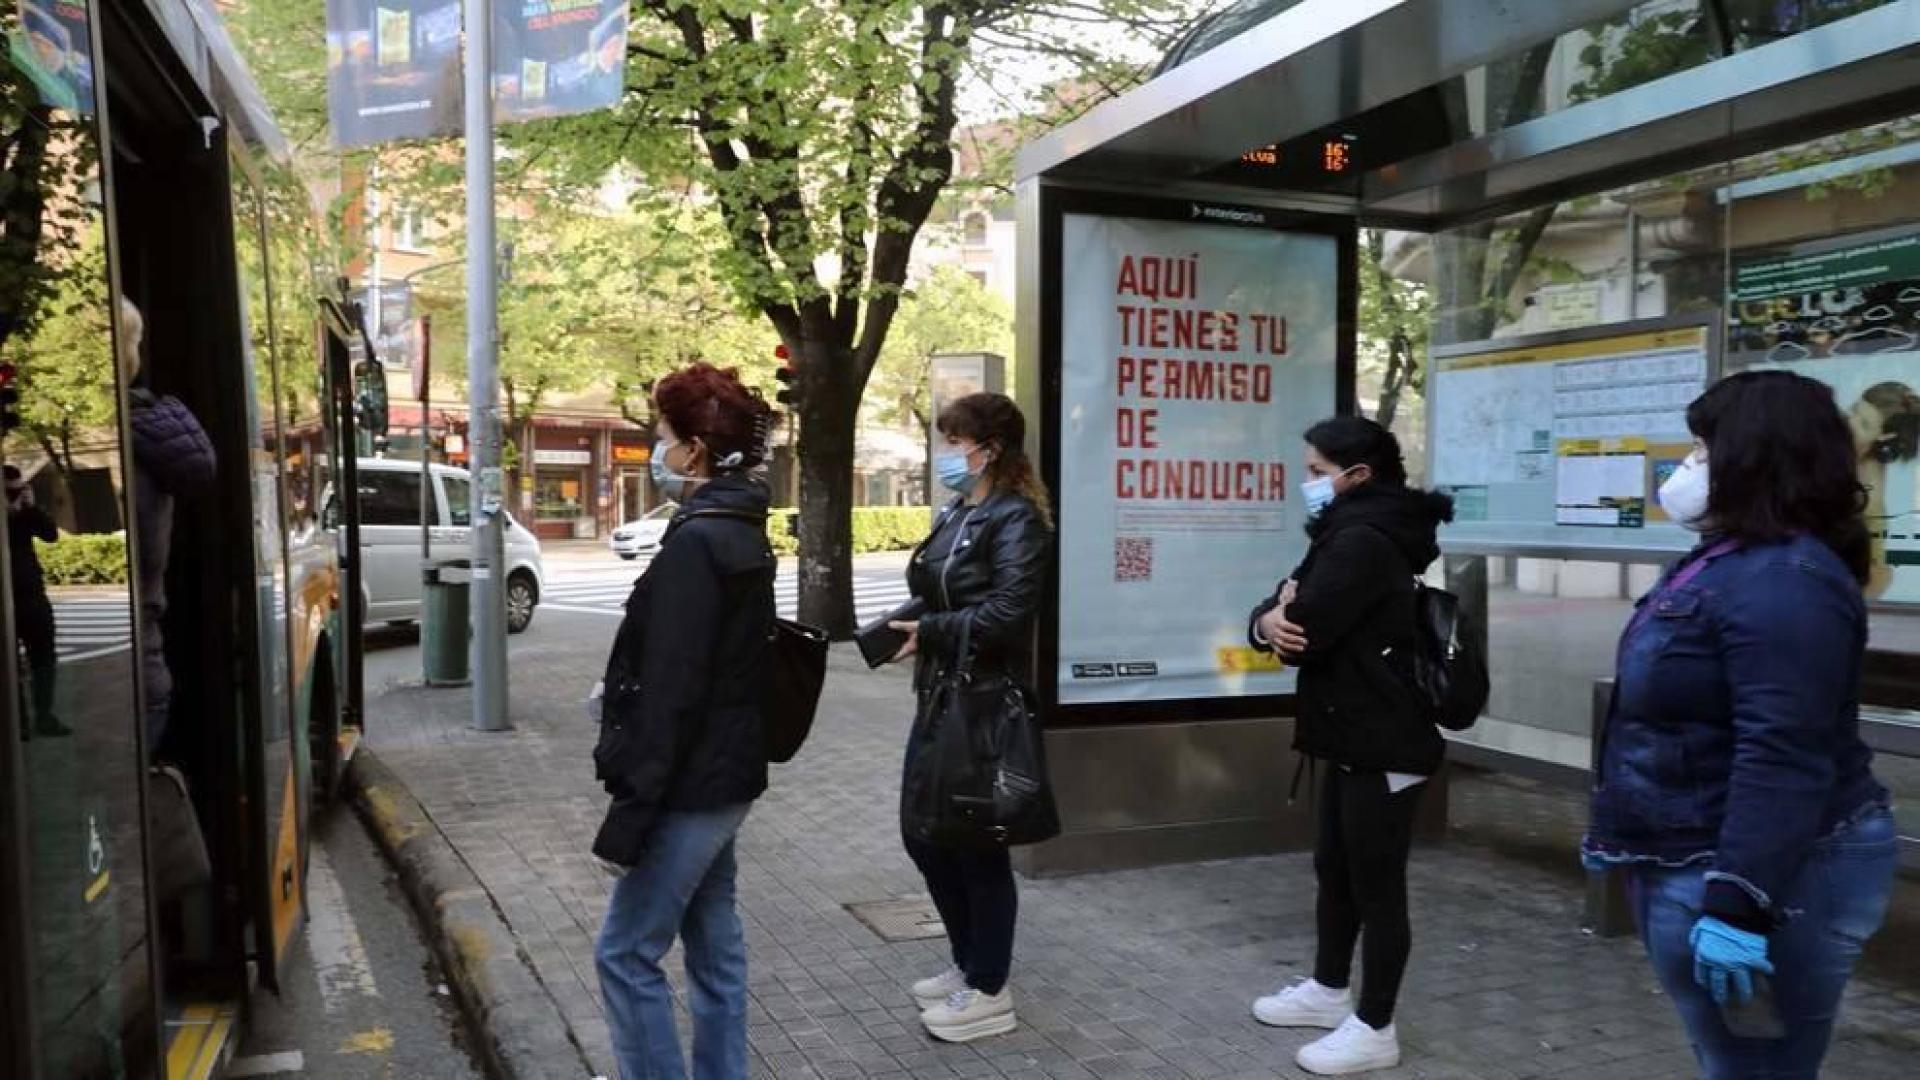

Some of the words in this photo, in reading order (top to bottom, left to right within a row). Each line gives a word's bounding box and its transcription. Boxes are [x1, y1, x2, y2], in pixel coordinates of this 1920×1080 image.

[1116, 252, 1199, 301] AQUÍ
[1116, 305, 1239, 352] TIENES
[1249, 314, 1288, 355] TU
[1116, 356, 1273, 403] PERMISO
[1116, 408, 1159, 449] DE
[1116, 459, 1286, 501] CONDUCIR
